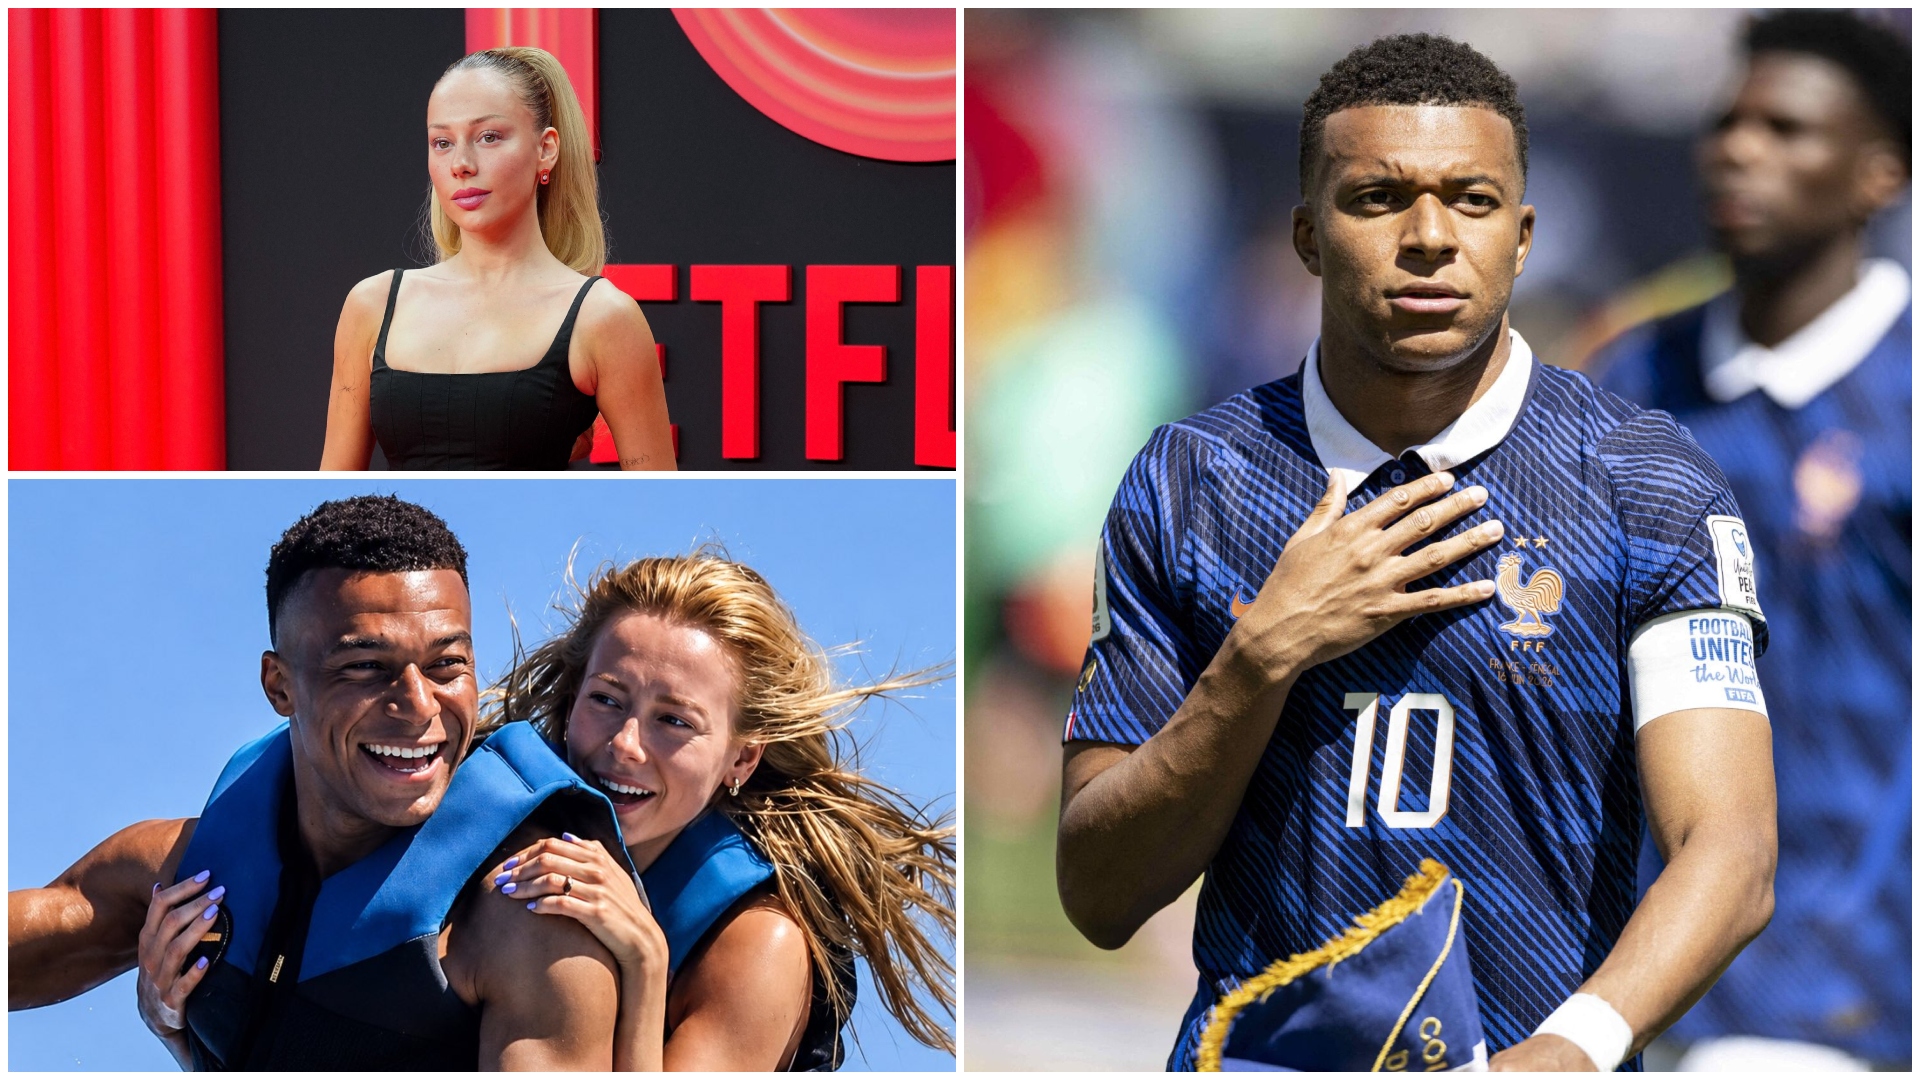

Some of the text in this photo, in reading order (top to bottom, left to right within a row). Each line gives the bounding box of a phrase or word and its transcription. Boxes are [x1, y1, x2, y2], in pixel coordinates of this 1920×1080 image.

[1690, 637, 1754, 669] UNITES
[1490, 658, 1519, 672] FRANCE
[1690, 663, 1725, 682] the
[1727, 689, 1756, 703] FIFA
[1343, 692, 1456, 829] 10
